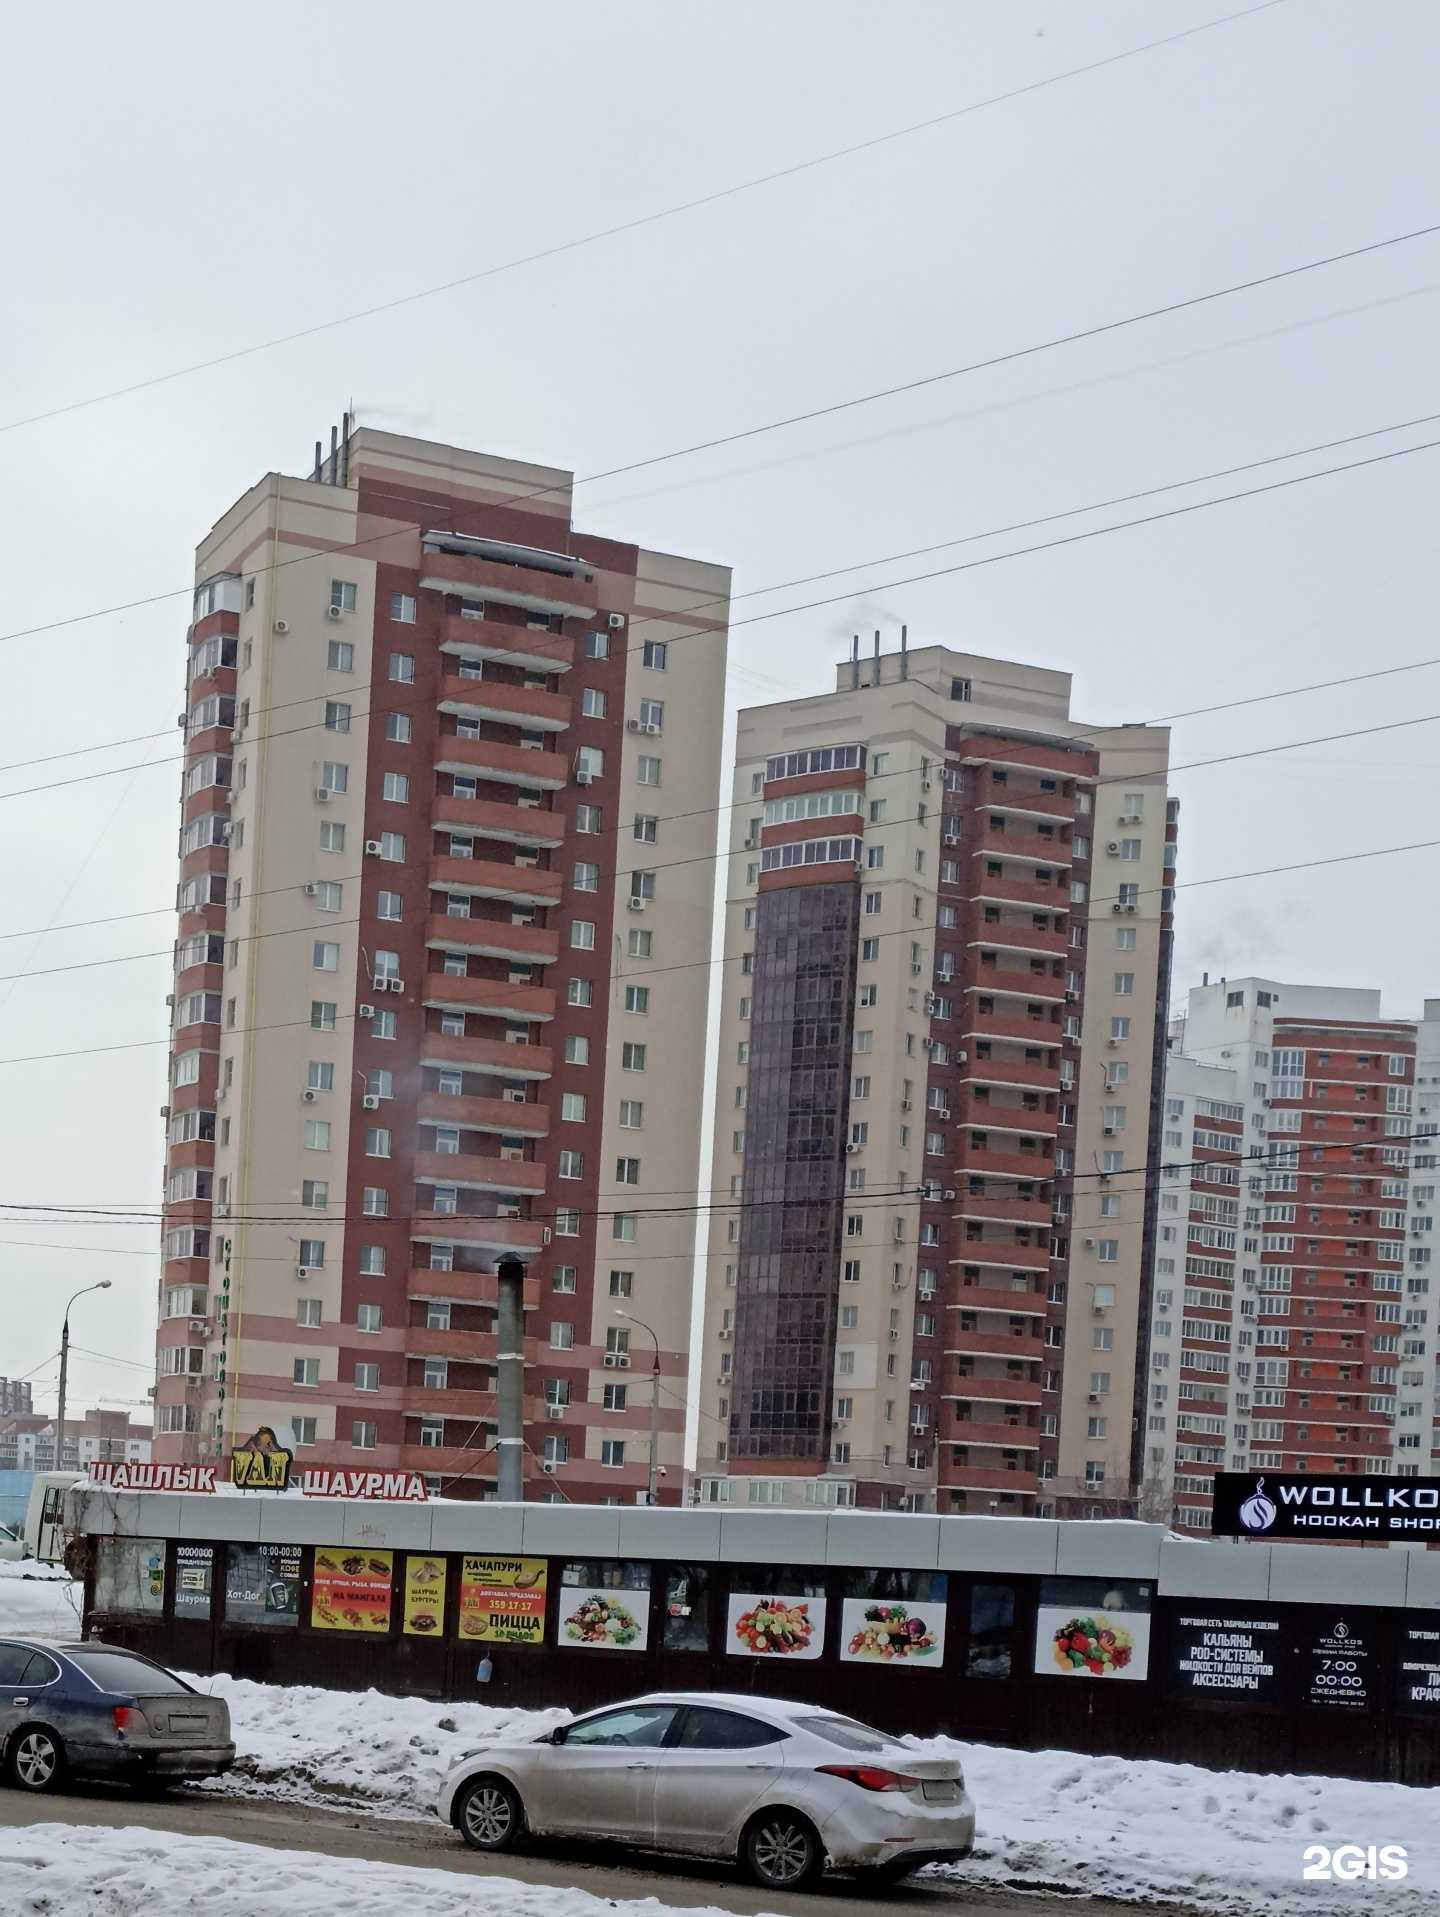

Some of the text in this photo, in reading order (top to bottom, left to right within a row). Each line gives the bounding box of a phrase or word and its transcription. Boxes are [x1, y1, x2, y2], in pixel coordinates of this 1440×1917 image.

[90, 1463, 215, 1490] ШАШЛЫК
[304, 1470, 425, 1499] ШАУРМА
[1279, 1486, 1439, 1508] WOLLKO
[1293, 1514, 1379, 1528] HOOKAH
[260, 1546, 302, 1557] 10:00-00:00
[280, 1565, 300, 1573] КОФЕ
[465, 1560, 523, 1572] ХАЧАПУРИ
[176, 1593, 210, 1606] Шаурма
[227, 1590, 261, 1601] Хот-Дог
[489, 1614, 540, 1632] ПИЦЦА
[1180, 1618, 1208, 1626] ТОРГОВАЯ
[1208, 1619, 1222, 1628] СЕТЬ
[1203, 1633, 1252, 1648] КАЛЬЯНЫ
[1408, 1630, 1439, 1640] ТОРГОВАЯ
[1190, 1646, 1263, 1663] POD-СИСТЕМЫ
[1180, 1660, 1274, 1676] ЖИДКОСТИ ДЛЯ ВЕЙПОВ
[1321, 1660, 1357, 1671] 7:00
[1192, 1673, 1259, 1689] АКСЕССУАРЫ
[1315, 1674, 1363, 1687] 00:00
[1310, 1687, 1367, 1697] ЕЖЕДНЕВНО
